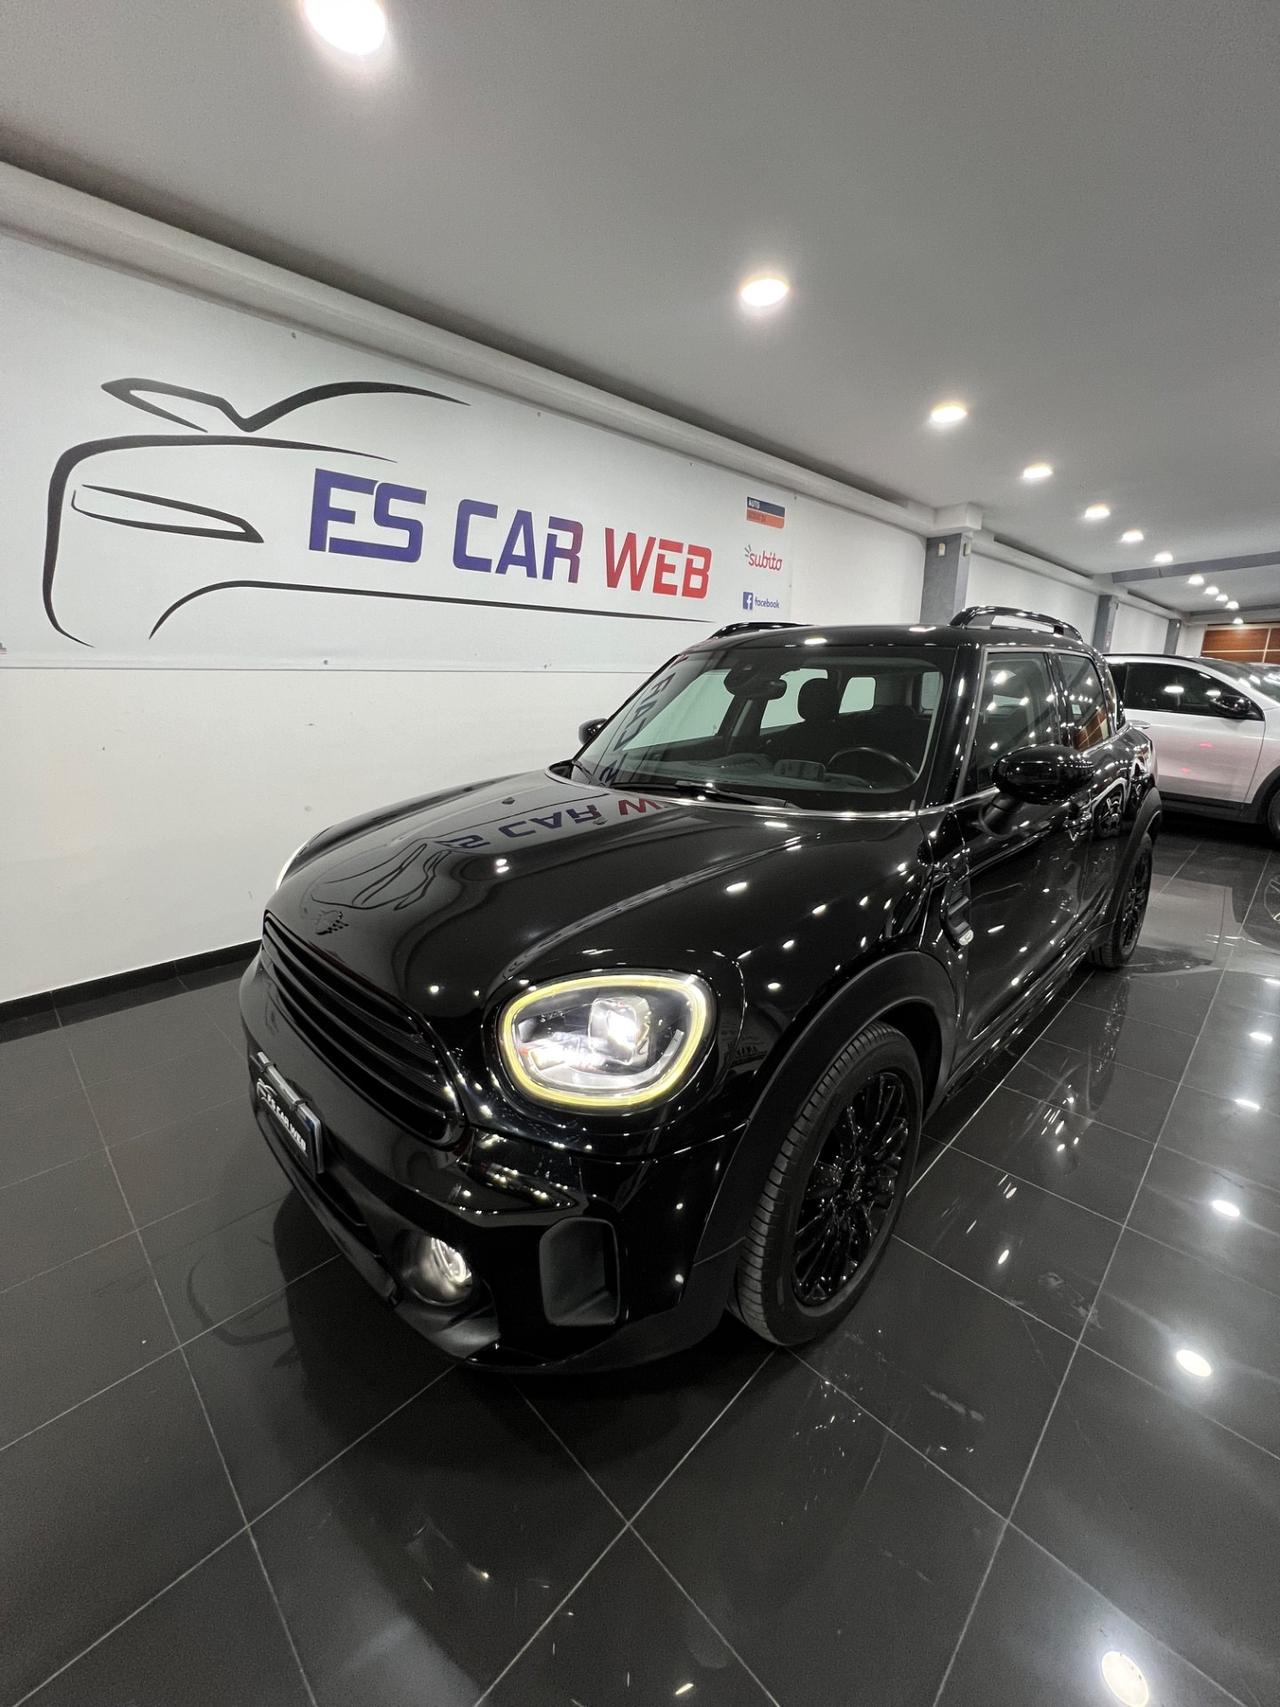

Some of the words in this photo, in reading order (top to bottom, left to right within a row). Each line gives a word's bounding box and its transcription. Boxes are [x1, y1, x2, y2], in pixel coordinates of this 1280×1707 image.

[309, 468, 427, 563] ES
[453, 499, 584, 584] CAR
[604, 527, 713, 599] WEB
[748, 550, 783, 571] subito
[754, 596, 780, 609] facebook
